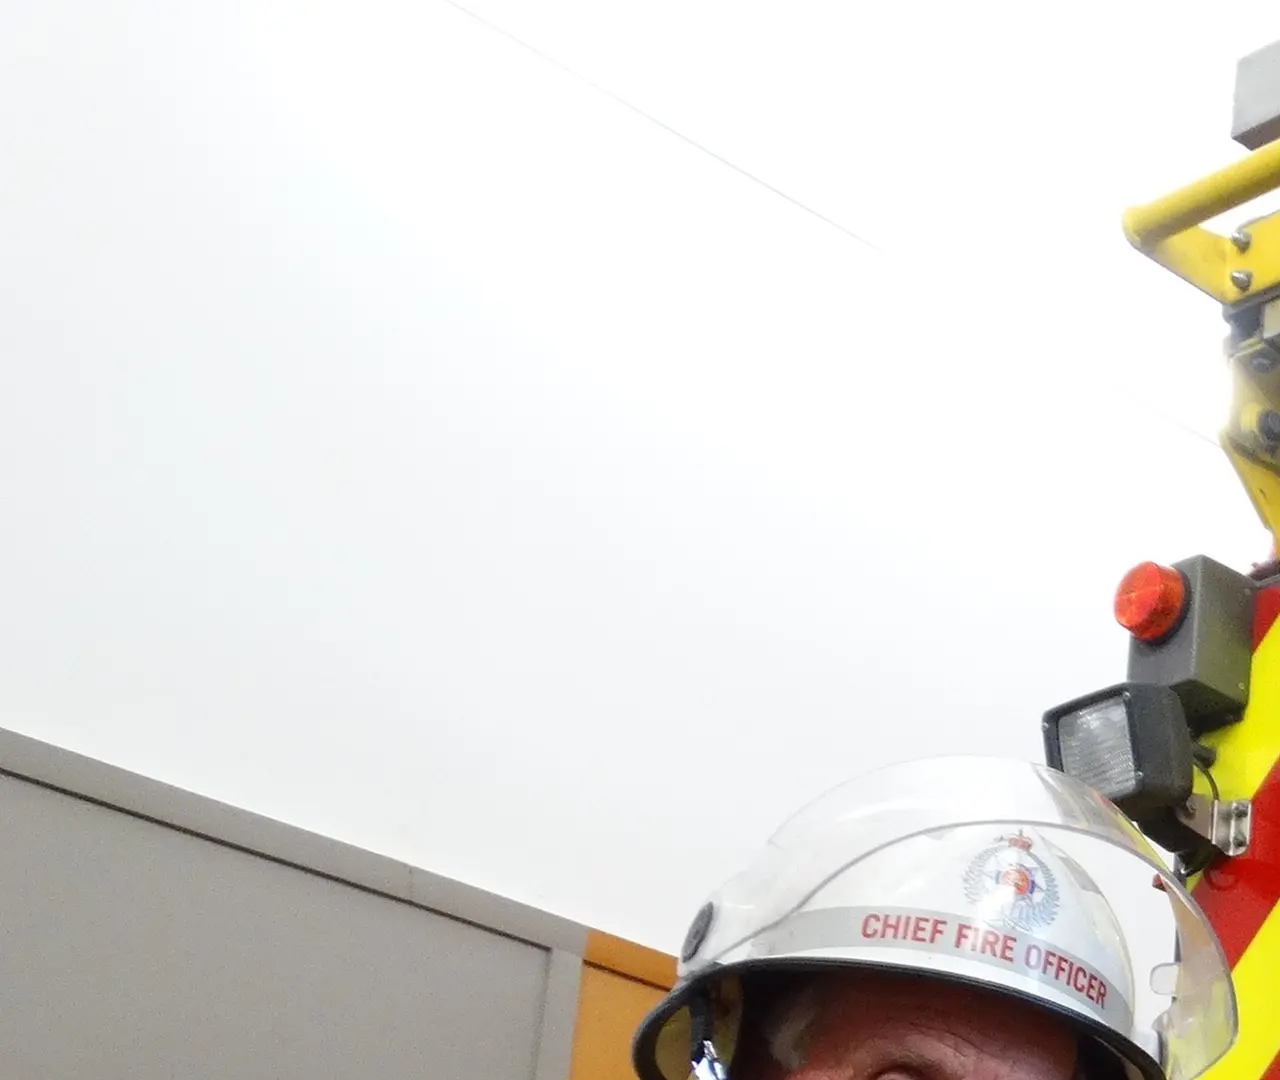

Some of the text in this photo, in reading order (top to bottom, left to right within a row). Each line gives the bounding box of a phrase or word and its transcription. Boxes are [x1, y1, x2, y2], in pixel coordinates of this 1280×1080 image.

[861, 913, 1107, 1010] CHIEF FIRE OFFICER
